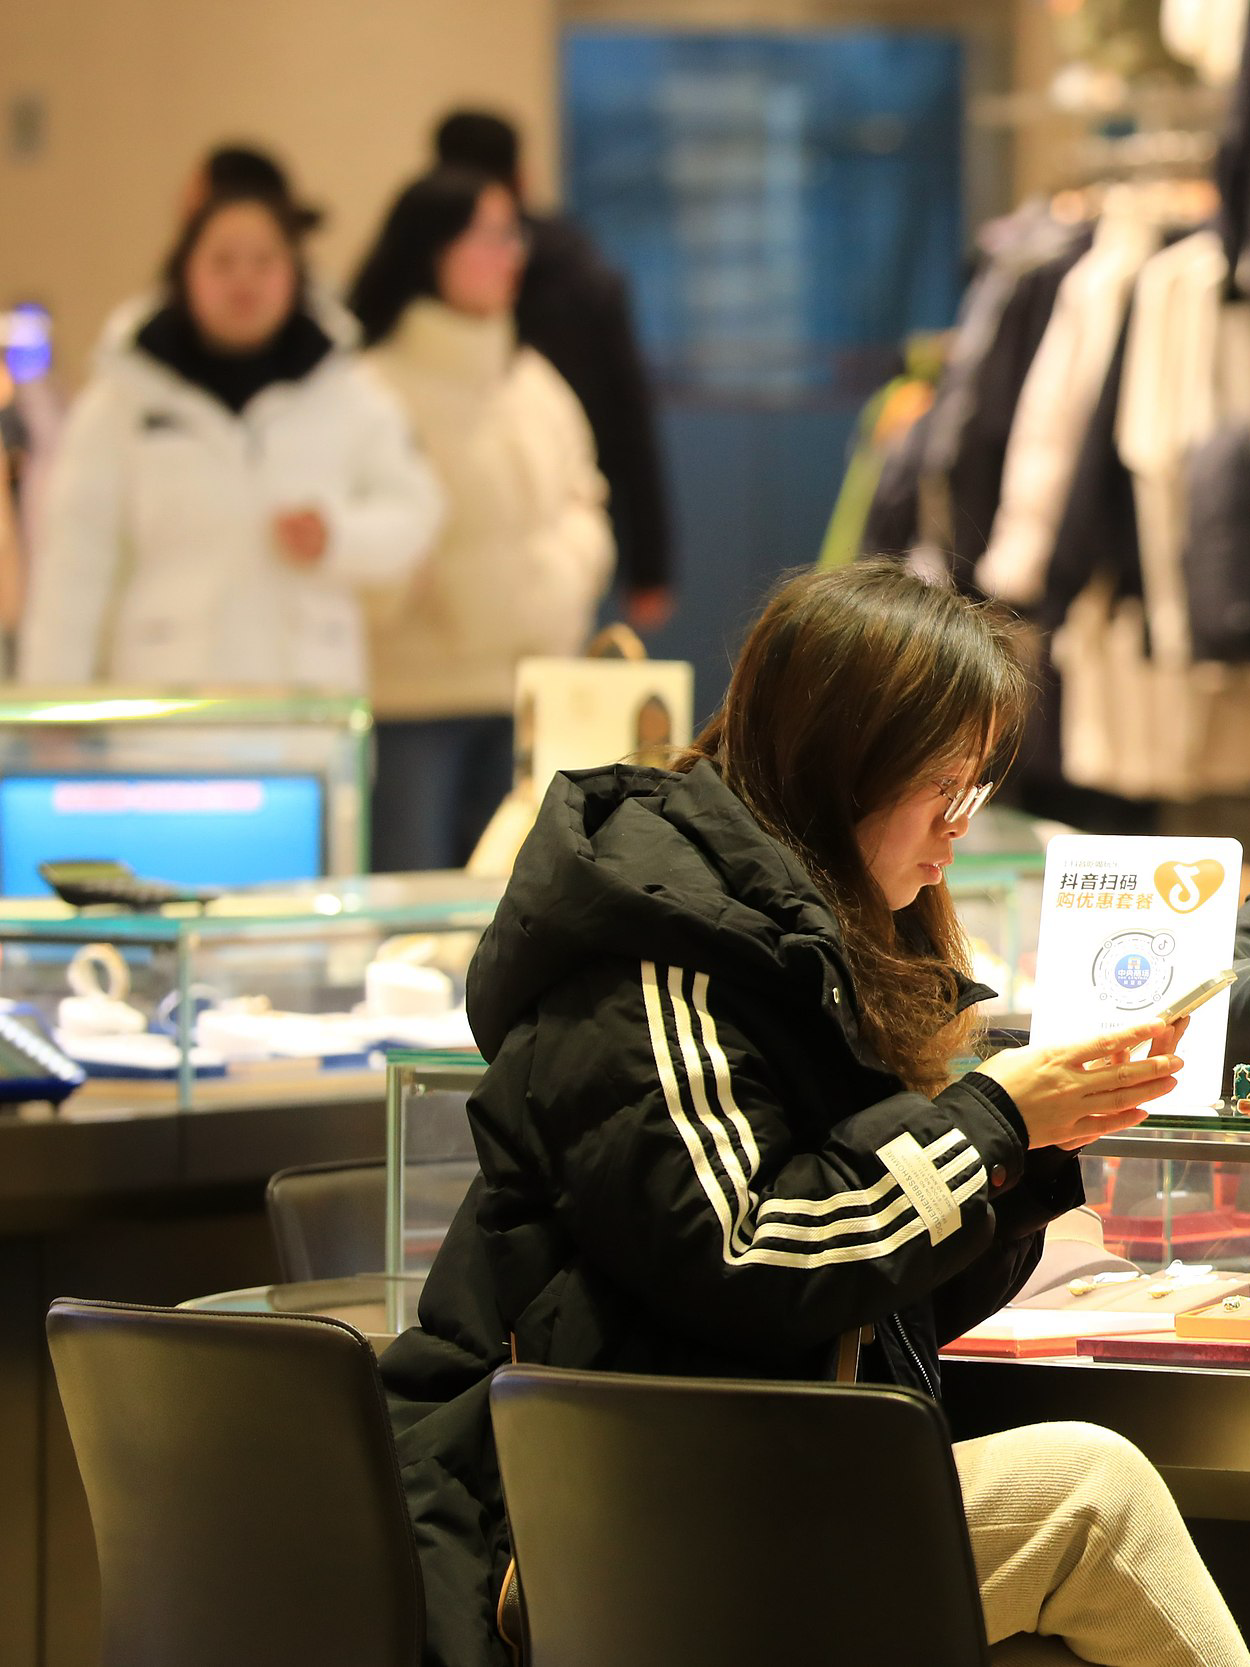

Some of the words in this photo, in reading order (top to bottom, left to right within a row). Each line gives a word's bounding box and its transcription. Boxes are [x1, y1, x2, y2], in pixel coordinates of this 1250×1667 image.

[1060, 873, 1137, 891] 抖音扫码
[1056, 892, 1154, 910] 购优惠套餐
